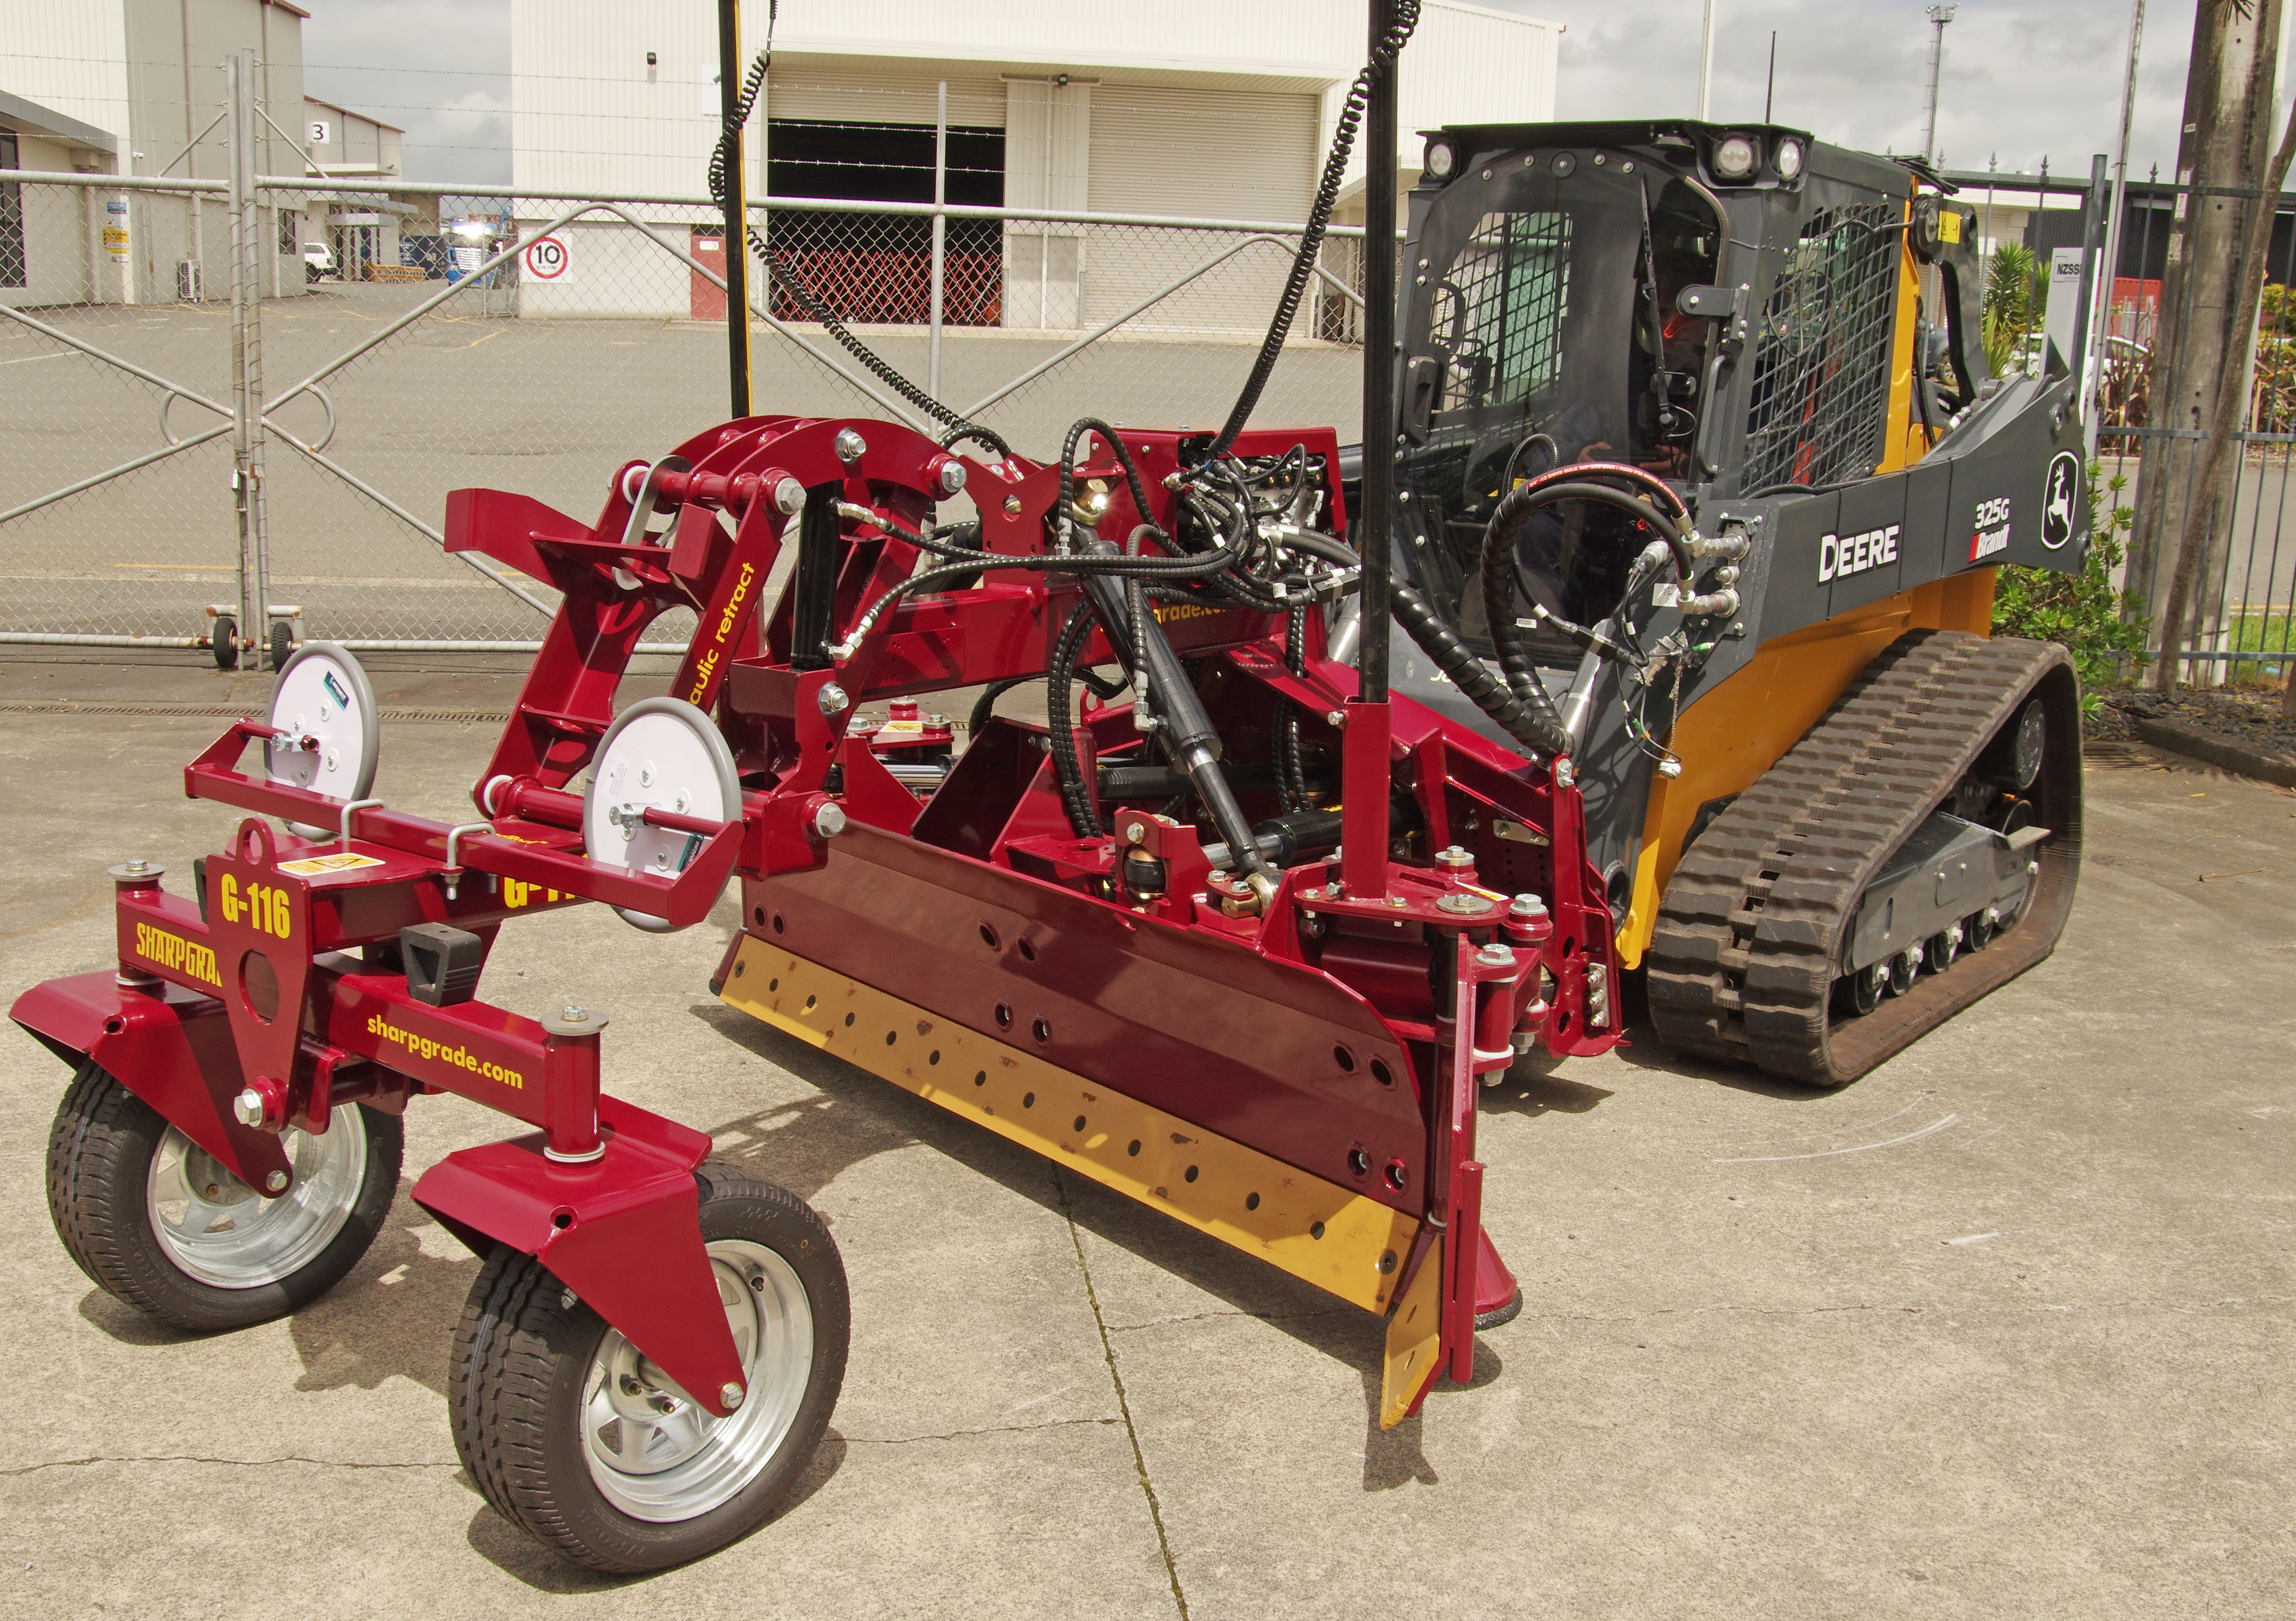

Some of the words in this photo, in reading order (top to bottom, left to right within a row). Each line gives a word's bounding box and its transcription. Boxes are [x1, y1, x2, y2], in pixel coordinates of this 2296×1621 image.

[313, 124, 324, 140] 3
[536, 245, 560, 264] 10
[2057, 264, 2081, 275] NZSS
[1548, 470, 1563, 479] DN19
[1975, 497, 2010, 529] 325G
[1819, 525, 1900, 583] DEERE
[1976, 523, 2010, 560] Brandt
[715, 562, 755, 644] retract
[221, 873, 291, 939] G-116
[136, 922, 223, 988] SHARPGRA
[367, 1013, 523, 1090] sharpgrade.com
